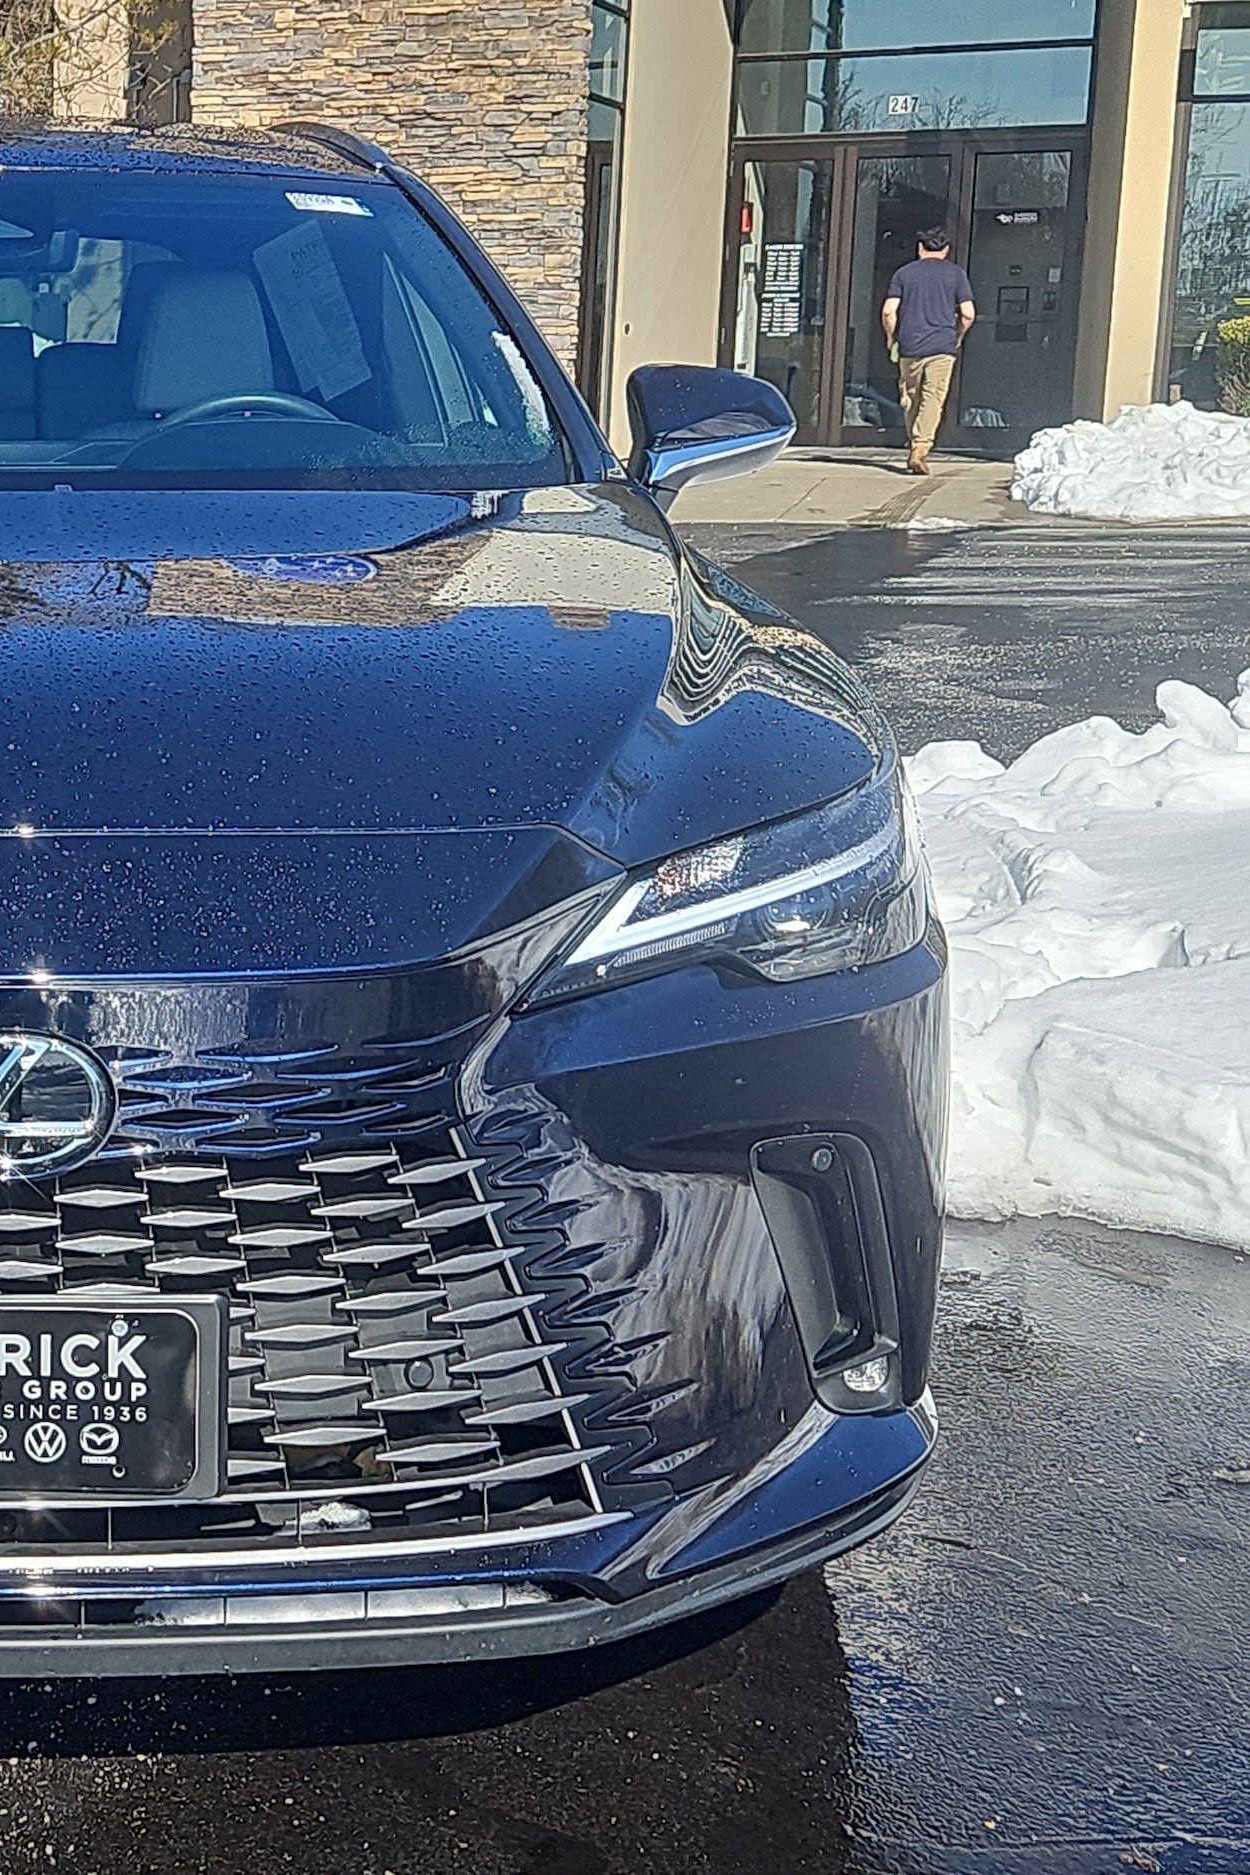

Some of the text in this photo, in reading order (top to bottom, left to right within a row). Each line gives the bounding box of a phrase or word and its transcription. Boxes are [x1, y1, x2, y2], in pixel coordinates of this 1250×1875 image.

[891, 97, 919, 113] 247
[22, 1379, 147, 1402] GROUP
[3, 1403, 79, 1420] SINCE
[92, 1405, 148, 1422] 1936
